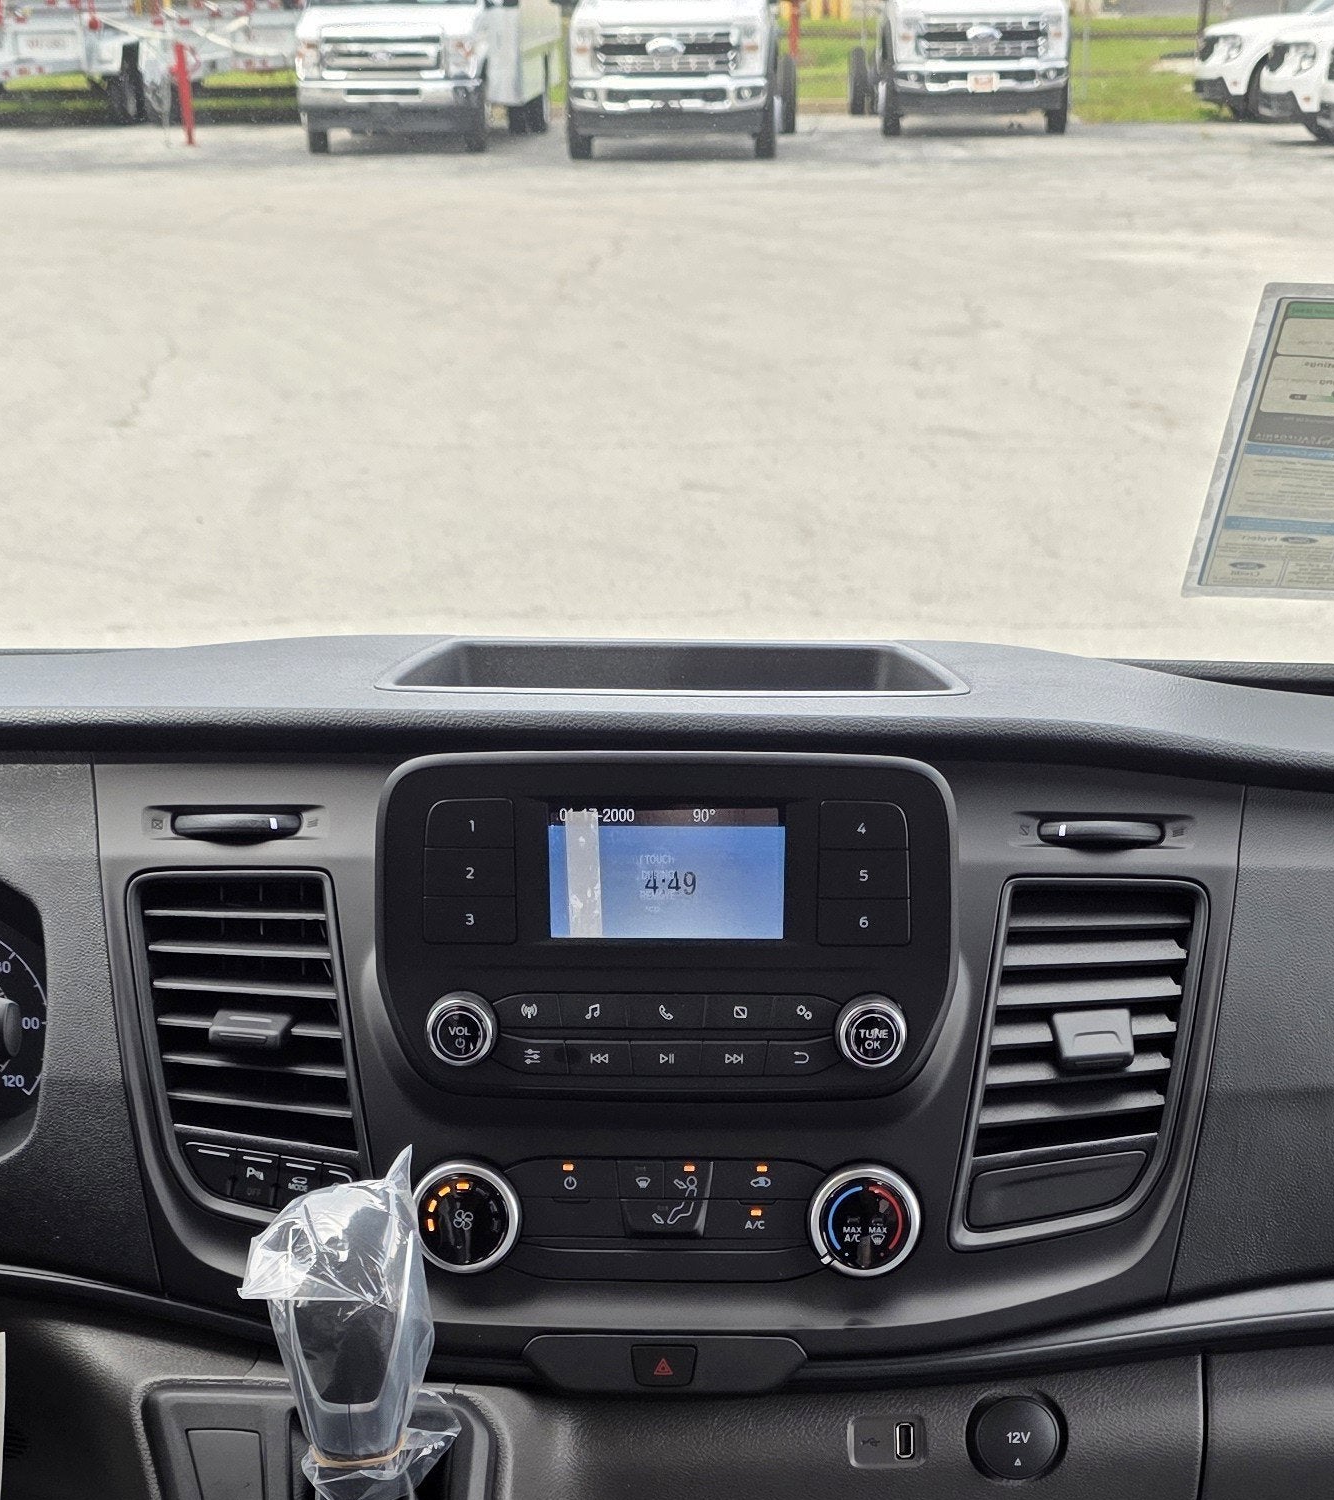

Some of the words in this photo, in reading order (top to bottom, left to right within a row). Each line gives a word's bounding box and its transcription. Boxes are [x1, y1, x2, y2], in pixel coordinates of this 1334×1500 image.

[692, 808, 716, 822] 90°
[468, 819, 475, 832] 1
[856, 822, 867, 835] 4
[465, 866, 475, 880] 2
[859, 869, 869, 882] 5
[465, 913, 475, 926] 3
[859, 916, 869, 928] 6
[21, 1016, 40, 1030] 00
[448, 1026, 472, 1036] VOL
[858, 1027, 889, 1040] TUNE
[865, 1040, 882, 1050] OK
[1, 1074, 25, 1088] 120
[744, 1220, 766, 1230] A/C
[842, 1226, 862, 1234] MAX
[868, 1226, 888, 1234] MAX
[843, 1234, 861, 1243] A/C
[1006, 1431, 1031, 1444] 12V
